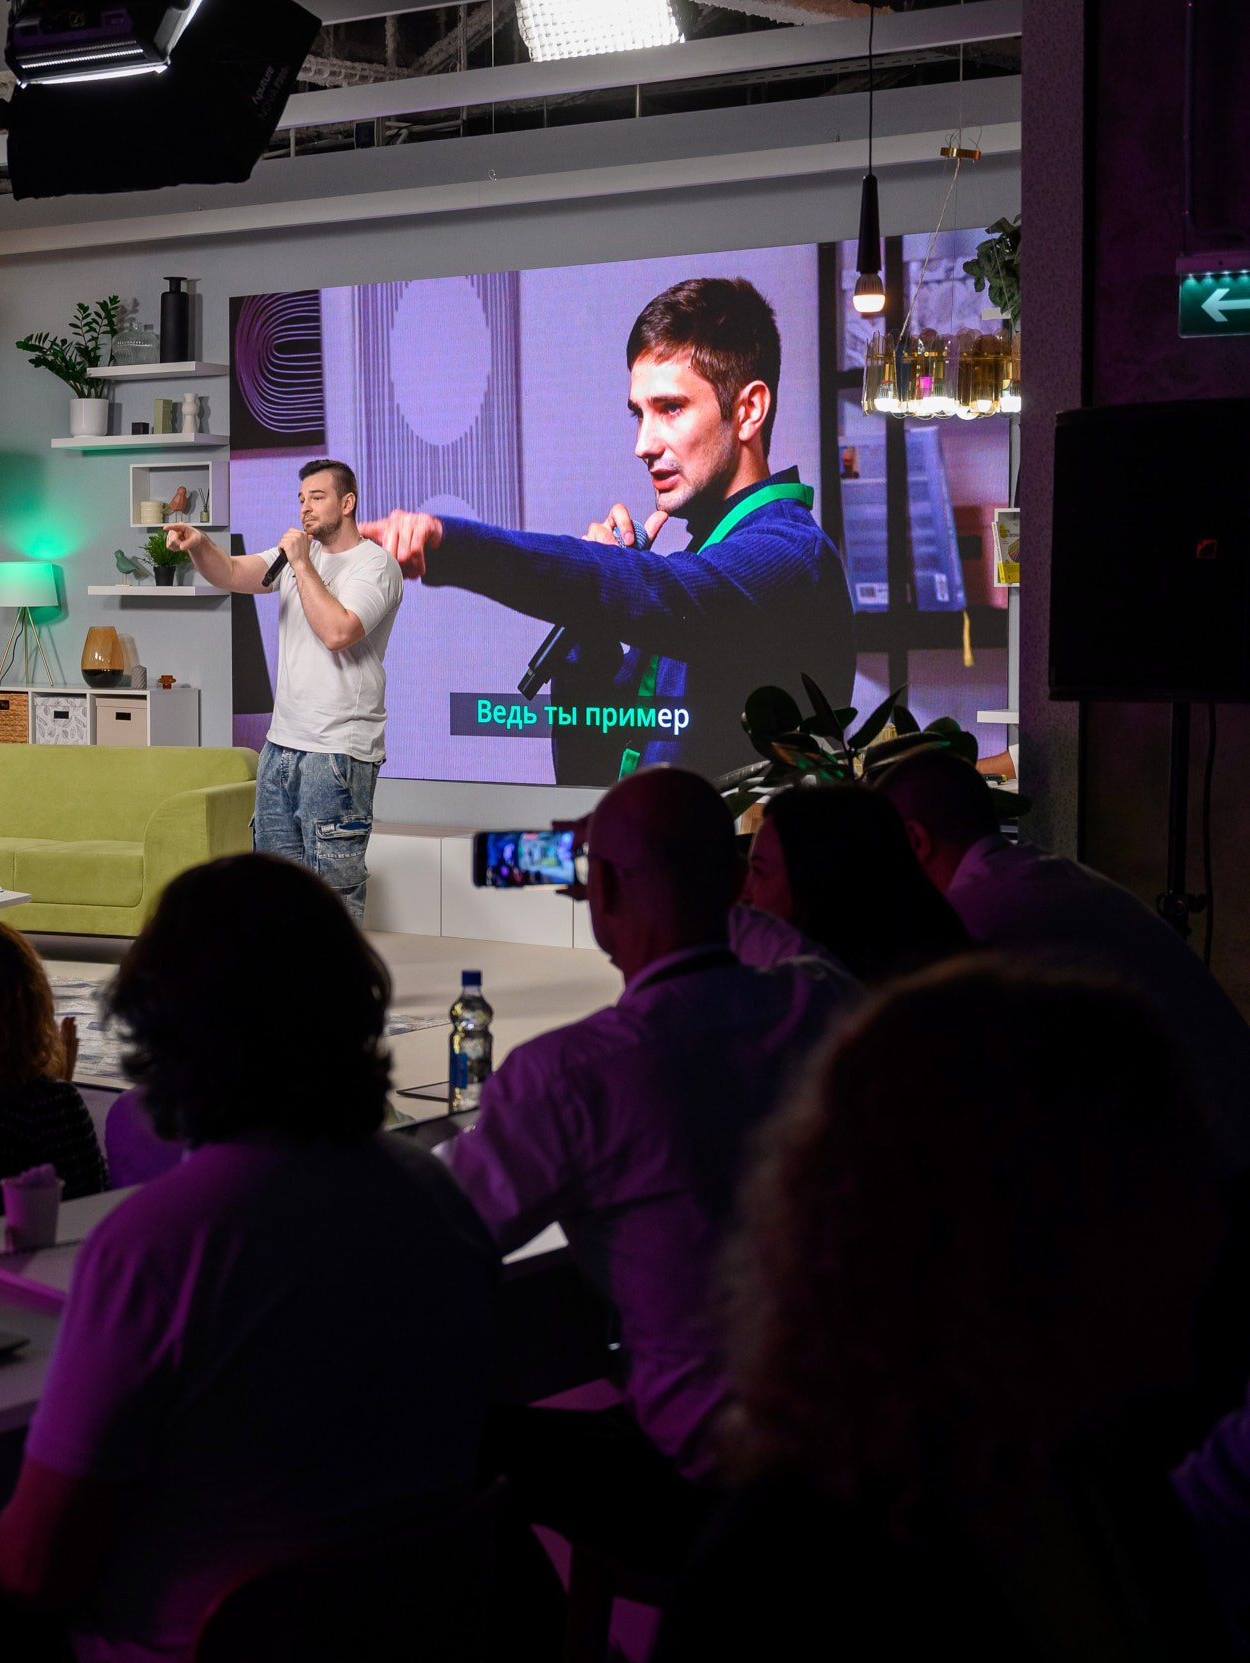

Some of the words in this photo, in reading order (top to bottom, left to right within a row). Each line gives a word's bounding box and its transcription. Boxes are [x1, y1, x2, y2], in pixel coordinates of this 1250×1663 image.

[477, 699, 537, 730] Ведь
[543, 706, 577, 725] ты
[586, 707, 689, 735] пример
